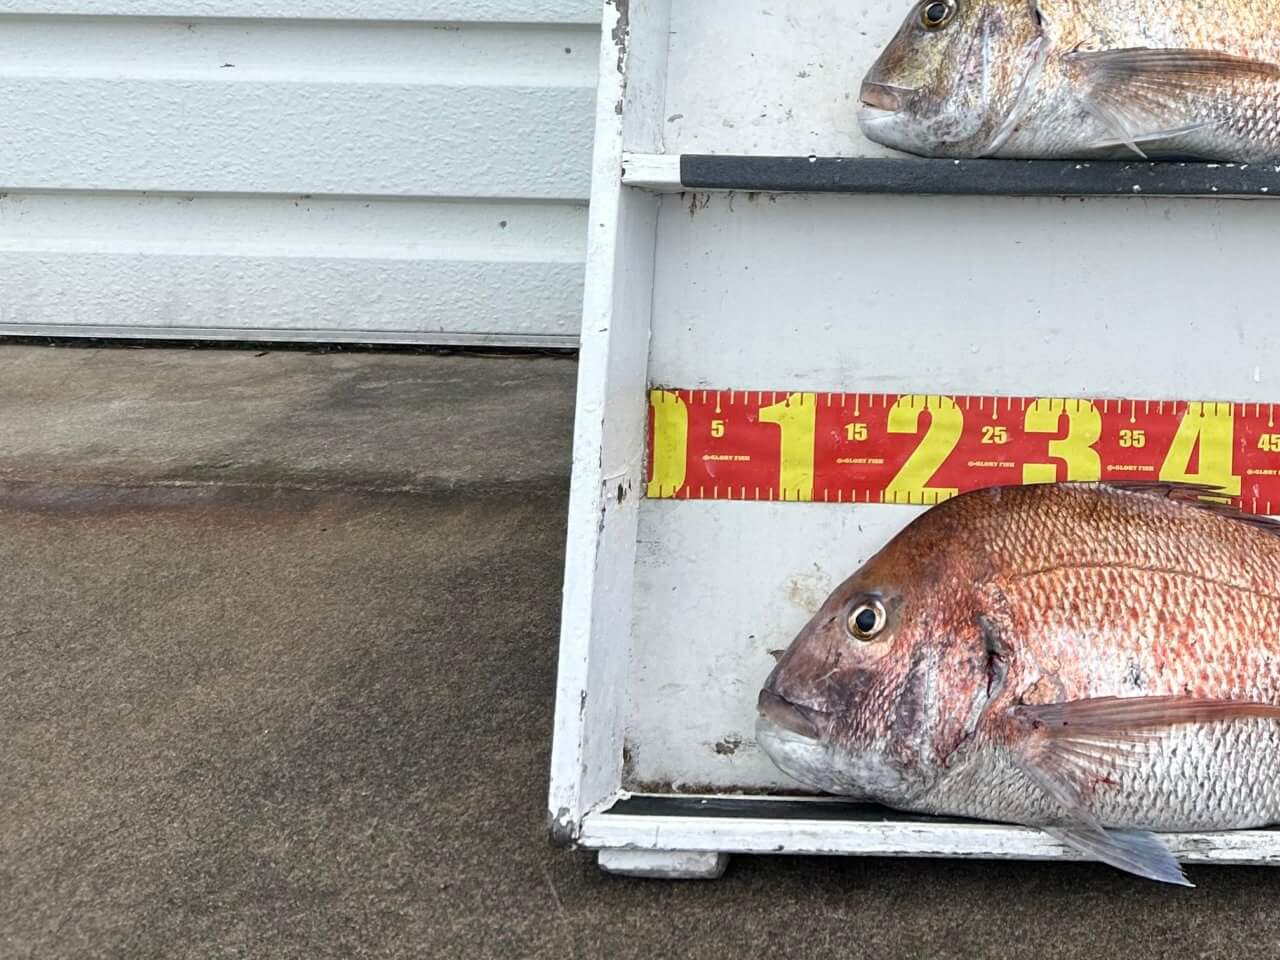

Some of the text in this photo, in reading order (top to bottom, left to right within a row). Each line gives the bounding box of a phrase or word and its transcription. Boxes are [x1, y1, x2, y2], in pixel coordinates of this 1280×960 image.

[711, 420, 725, 437] 5
[759, 393, 816, 501] 1
[844, 423, 868, 441] 15
[884, 395, 964, 504] 2
[982, 426, 1008, 444] 25
[1022, 398, 1102, 485] 3
[1119, 430, 1146, 447] 35
[1159, 401, 1242, 504] 4
